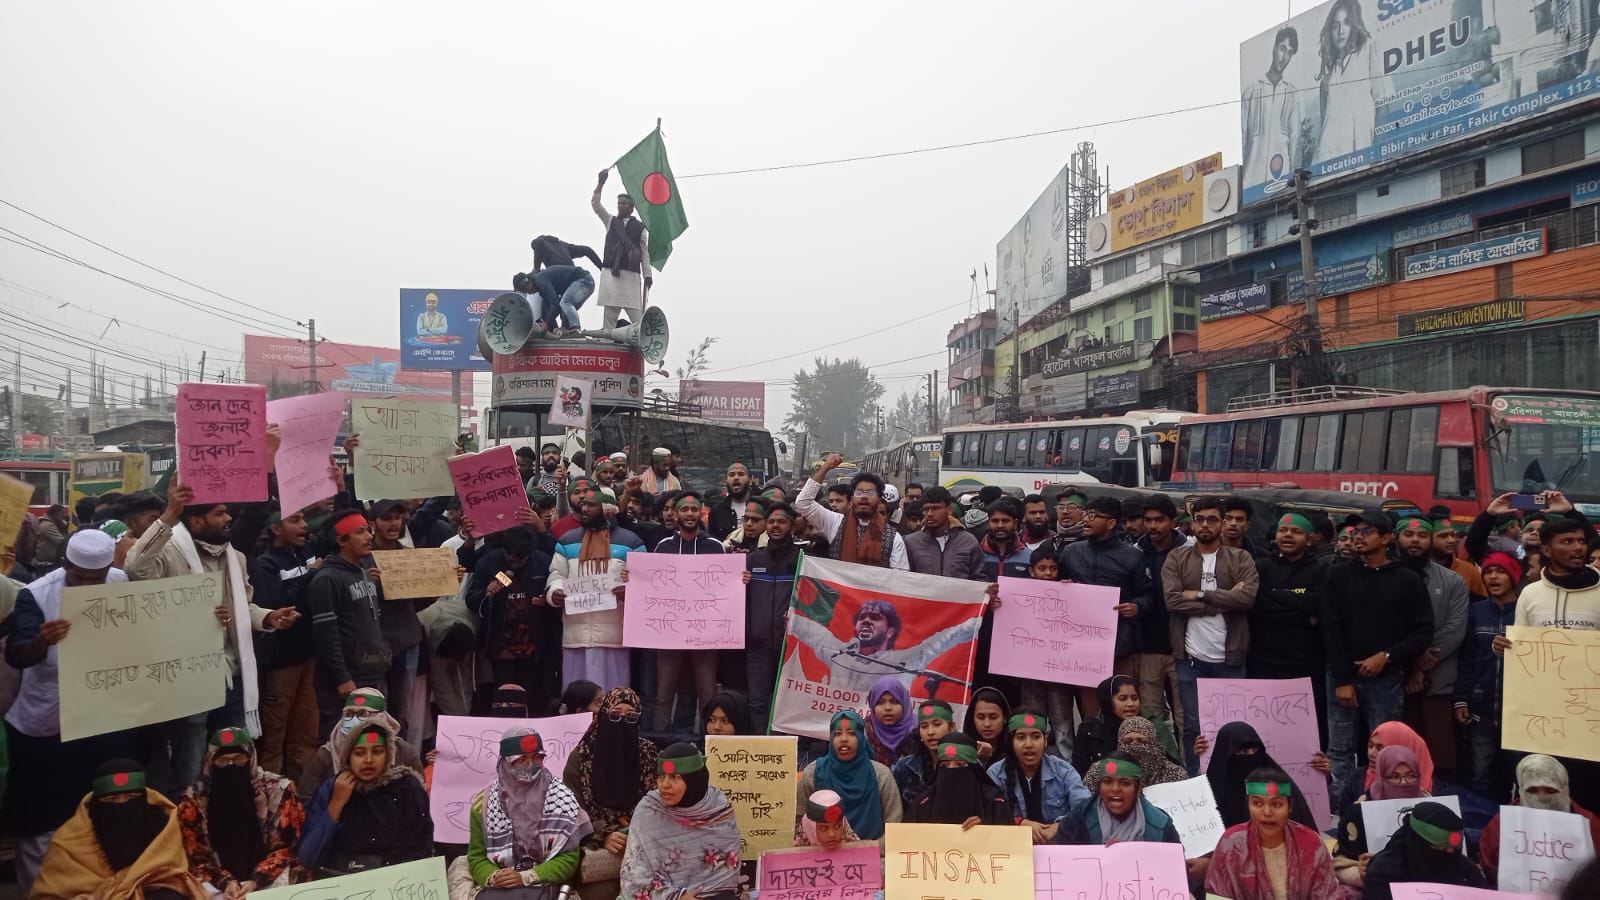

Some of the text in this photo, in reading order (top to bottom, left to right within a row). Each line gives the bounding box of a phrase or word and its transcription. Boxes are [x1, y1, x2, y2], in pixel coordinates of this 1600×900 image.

[1383, 16, 1470, 75] DHEU
[1374, 91, 1485, 135] www.saralifestyle.com
[1321, 154, 1364, 175] Location
[1381, 139, 1405, 156] Bibir
[1407, 129, 1440, 147] Pukur
[1442, 121, 1465, 137] Par,
[1468, 110, 1498, 128] Fakir
[1567, 79, 1592, 97] 112
[1575, 179, 1600, 196] HO
[1408, 254, 1446, 275] হোটেল
[1487, 236, 1540, 258] আবাসিক
[1453, 301, 1501, 327] CONVENTION
[1502, 299, 1522, 320] HALL
[539, 352, 570, 367] আইন
[571, 355, 597, 367] মেনে
[598, 355, 621, 371] চলুন
[1043, 357, 1071, 375] হোটেল
[1106, 344, 1132, 361] আবাসিক
[509, 376, 539, 390] বরিশাল
[361, 399, 421, 430] আমি
[730, 396, 762, 410] ISPAT
[1509, 406, 1543, 417] বরিশাল
[195, 417, 252, 439] জুলাই
[567, 577, 610, 594] WE'RE
[688, 564, 733, 591] হাদি
[81, 594, 138, 629] বাংলা
[573, 593, 603, 609] HADI
[645, 611, 681, 634] হাদি
[1009, 626, 1046, 649] নিপাত
[1514, 629, 1579, 681] হাদি
[85, 665, 139, 691] ভারত
[787, 679, 861, 704] THE BLOOD
[810, 699, 842, 714] 2025
[750, 753, 786, 765] আমার
[1513, 830, 1576, 862] Justice
[843, 863, 867, 882] যে
[899, 850, 1011, 885] INSAF
